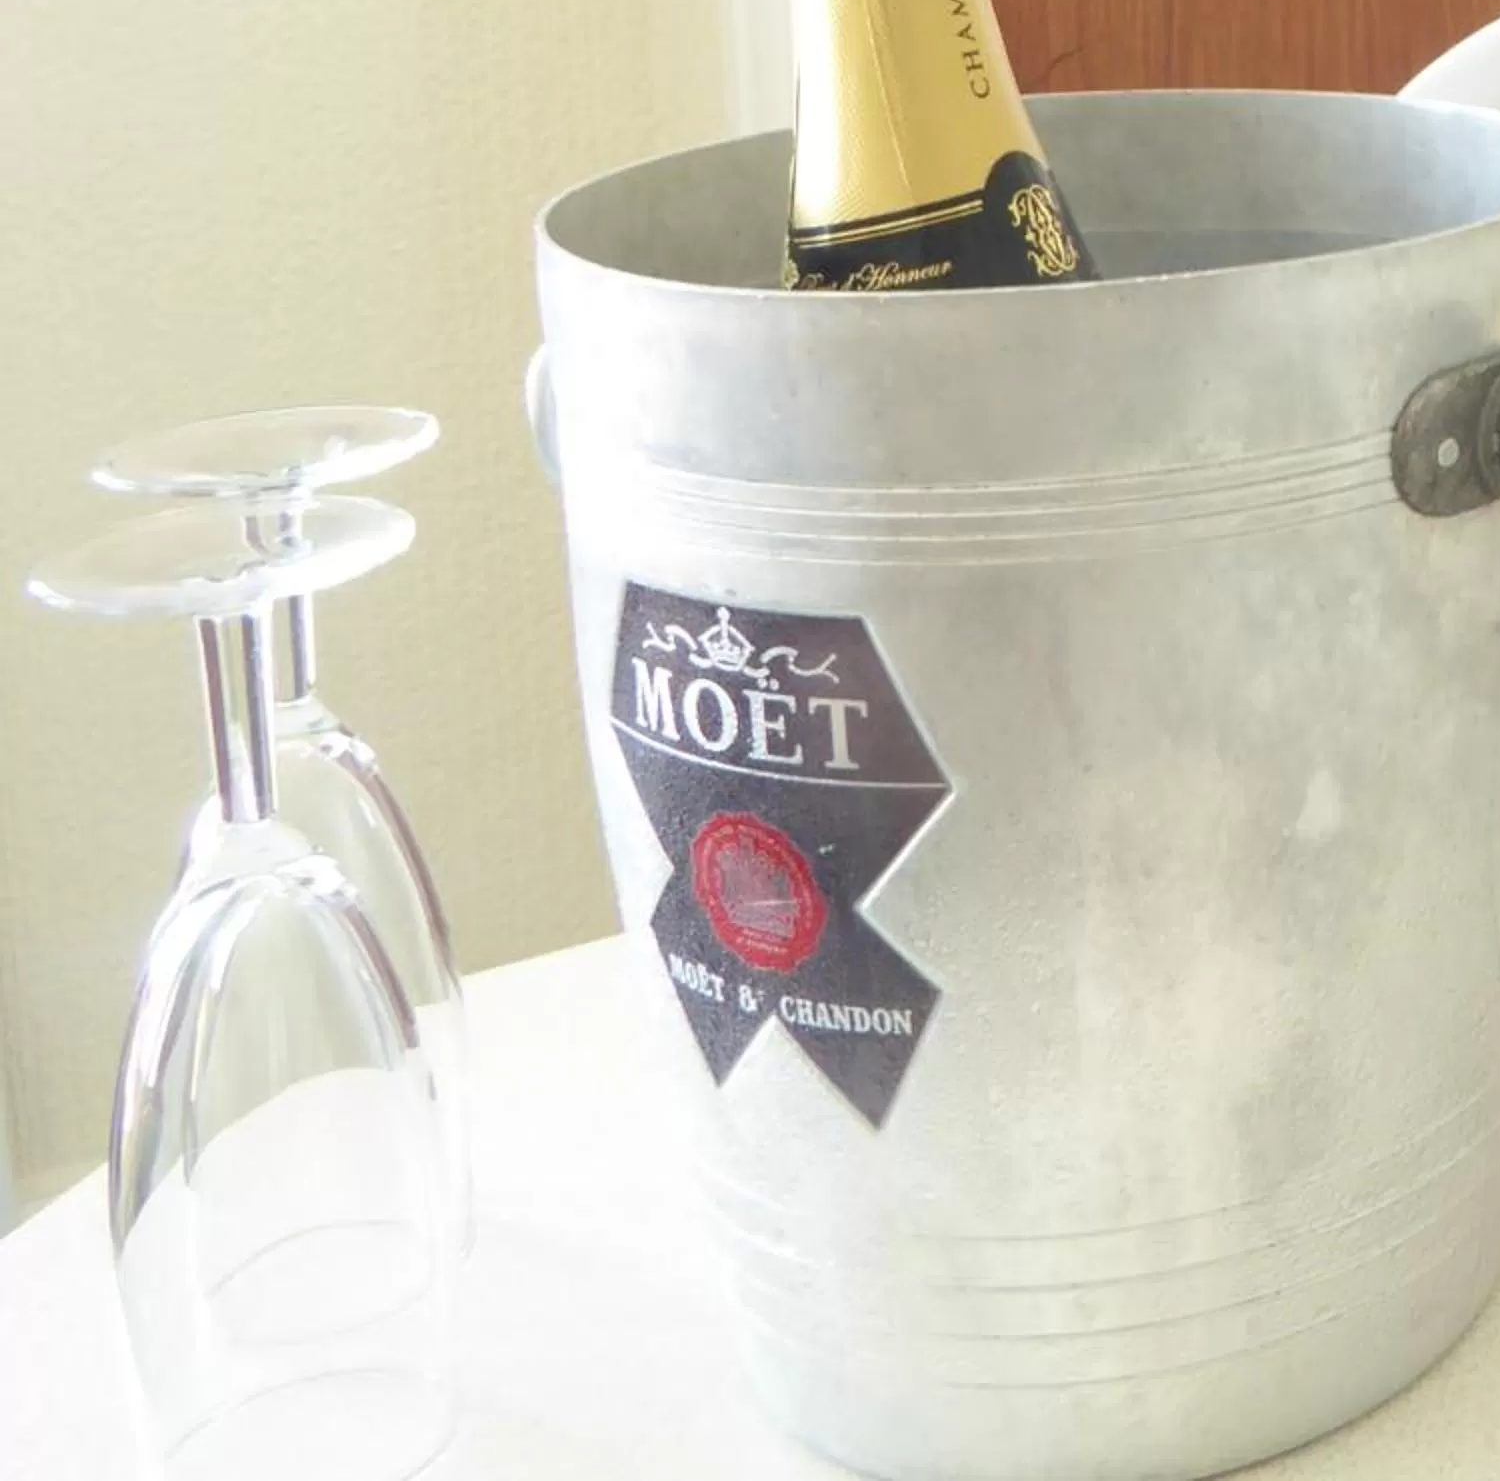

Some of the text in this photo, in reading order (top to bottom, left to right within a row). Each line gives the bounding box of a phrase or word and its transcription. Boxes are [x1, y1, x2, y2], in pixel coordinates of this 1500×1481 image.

[631, 656, 868, 770] MOËT
[738, 984, 758, 1012] &
[779, 996, 912, 1035] CHANDON
